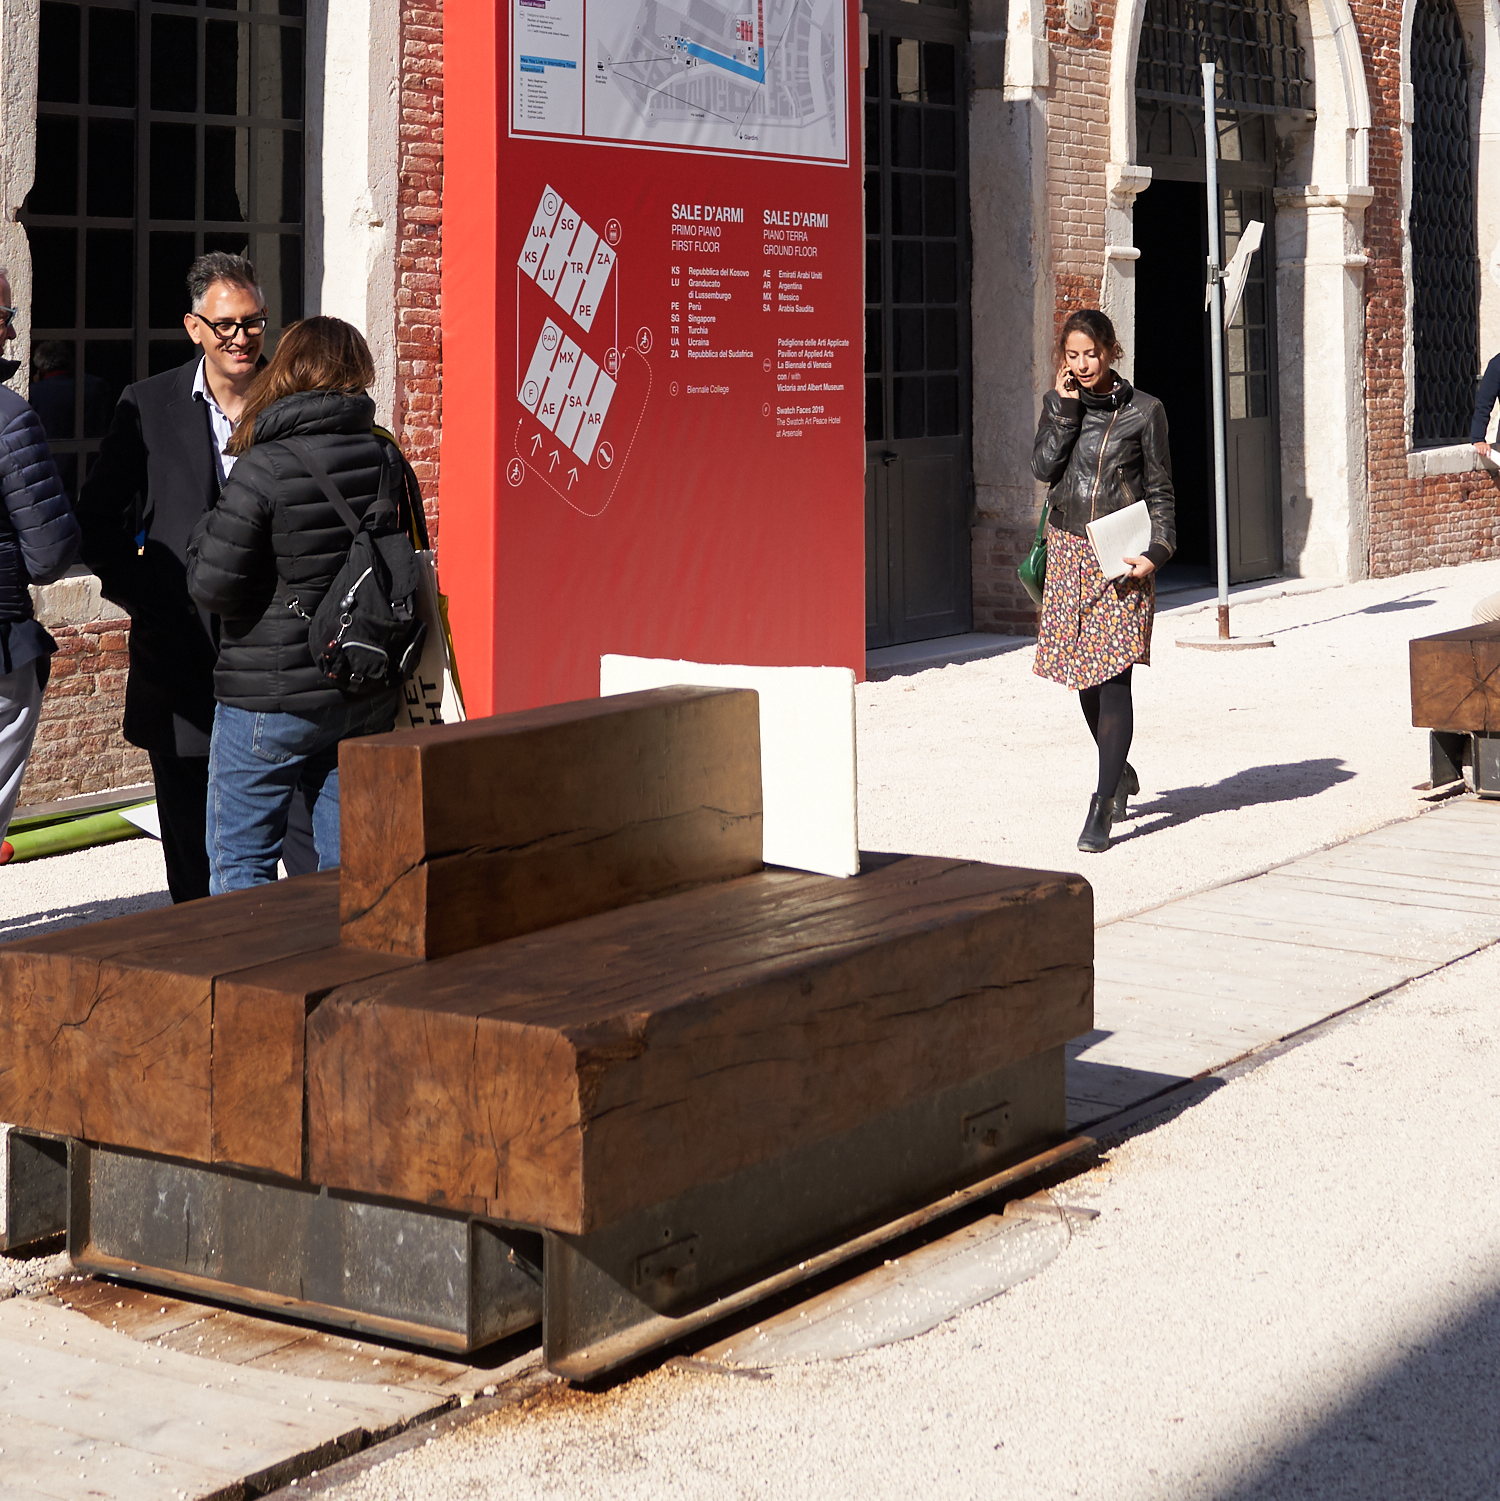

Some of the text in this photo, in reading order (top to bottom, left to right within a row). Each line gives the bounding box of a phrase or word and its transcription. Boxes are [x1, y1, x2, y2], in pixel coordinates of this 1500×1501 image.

[672, 203, 701, 220] SALE
[763, 209, 790, 225] SALE
[561, 219, 574, 230] SG
[532, 226, 546, 237] UA
[671, 224, 721, 237] PRIMO PIANO
[763, 230, 808, 241] PIANO TERRA
[671, 240, 720, 252] FIRST FLOOR
[763, 244, 817, 257] GROUND FLOOR
[524, 251, 537, 263] KS
[598, 253, 610, 264] ZA
[571, 262, 583, 273] TR
[671, 266, 680, 275] KS
[689, 267, 749, 277] Repubblica del Kosovo
[542, 269, 555, 280] LU
[763, 270, 771, 278] AE
[779, 270, 796, 278] Emirati
[797, 271, 810, 279] Arabi
[671, 278, 680, 286] LU
[689, 279, 720, 288] Granducato
[763, 281, 771, 289] AR
[779, 282, 802, 291] Argentina
[695, 291, 731, 301] Lussemburgo
[778, 293, 799, 301] Messico
[580, 305, 591, 316] PE
[671, 302, 679, 310] PE
[763, 304, 770, 312] SA
[778, 304, 814, 313] Arabia Saudita
[671, 314, 680, 322] SG
[688, 314, 716, 324] Singapore
[671, 326, 679, 334] TR
[688, 326, 708, 334] Turchia
[671, 338, 680, 346] UA
[688, 338, 709, 346] Ucraina
[777, 338, 804, 348] Padiglione
[827, 339, 849, 348] Applicate
[559, 352, 574, 363] MX
[670, 350, 679, 358] ZA
[688, 350, 753, 359] Repubblica del Sudafrica
[798, 349, 804, 357] of
[804, 350, 823, 359] Applied
[777, 361, 784, 369] La
[785, 361, 806, 369] Biennale
[687, 385, 729, 394] Biennale College
[777, 384, 796, 392] Victoria
[569, 395, 582, 407] SA
[542, 403, 555, 415] AE
[777, 406, 795, 414] Swatch
[796, 406, 811, 414] Faces
[588, 413, 601, 424] AR
[787, 417, 804, 425] Swatch
[828, 416, 840, 424] Hotel
[782, 429, 802, 437] Arsenale
